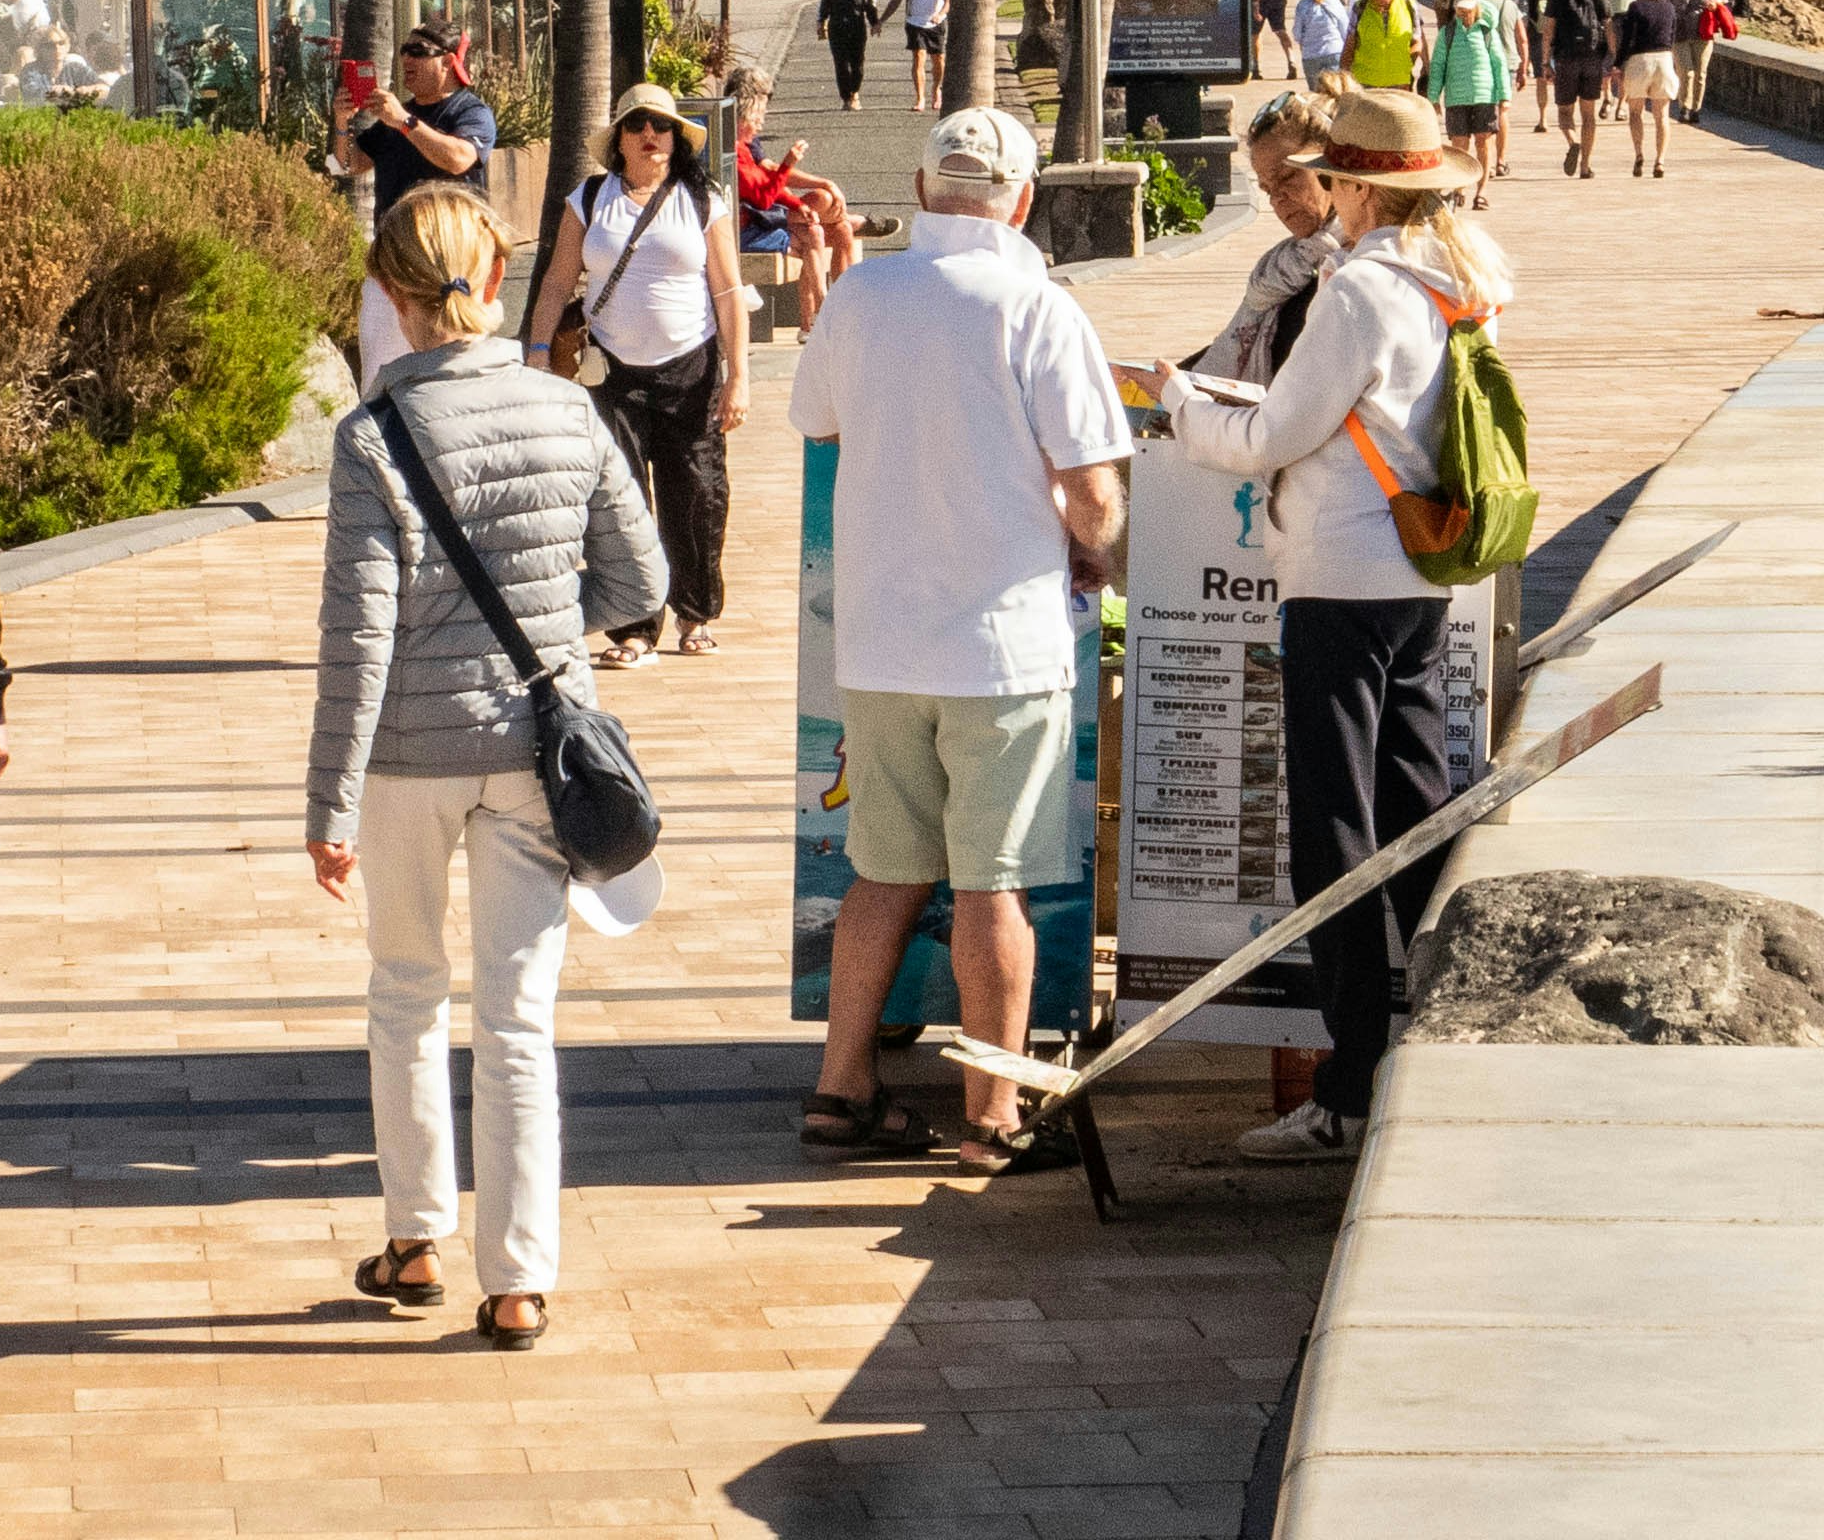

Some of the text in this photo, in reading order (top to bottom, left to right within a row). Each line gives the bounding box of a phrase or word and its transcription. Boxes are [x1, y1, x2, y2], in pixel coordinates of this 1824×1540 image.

[1202, 567, 1279, 603] Ren
[1141, 606, 1197, 621] Choose
[1202, 612, 1237, 624] your
[1242, 611, 1269, 624] Car
[1447, 620, 1475, 633] otel
[1161, 643, 1221, 655] PEQUEÑO
[1150, 672, 1230, 684] ECONÓMICO
[1449, 665, 1472, 679] 240
[1153, 701, 1227, 711] COMPACTO
[1449, 695, 1472, 709] 270
[1176, 730, 1203, 740] SUV
[1447, 724, 1470, 738] 350
[1159, 759, 1166, 767] 7
[1169, 759, 1217, 769] PLAZAS
[1169, 788, 1218, 798] PLAZAS
[1137, 816, 1236, 828] DESCAPOTABLE
[1139, 845, 1202, 856] PREMIUM
[1205, 848, 1232, 857] CAR
[1135, 874, 1235, 887] EXCLUSIVE CAR
